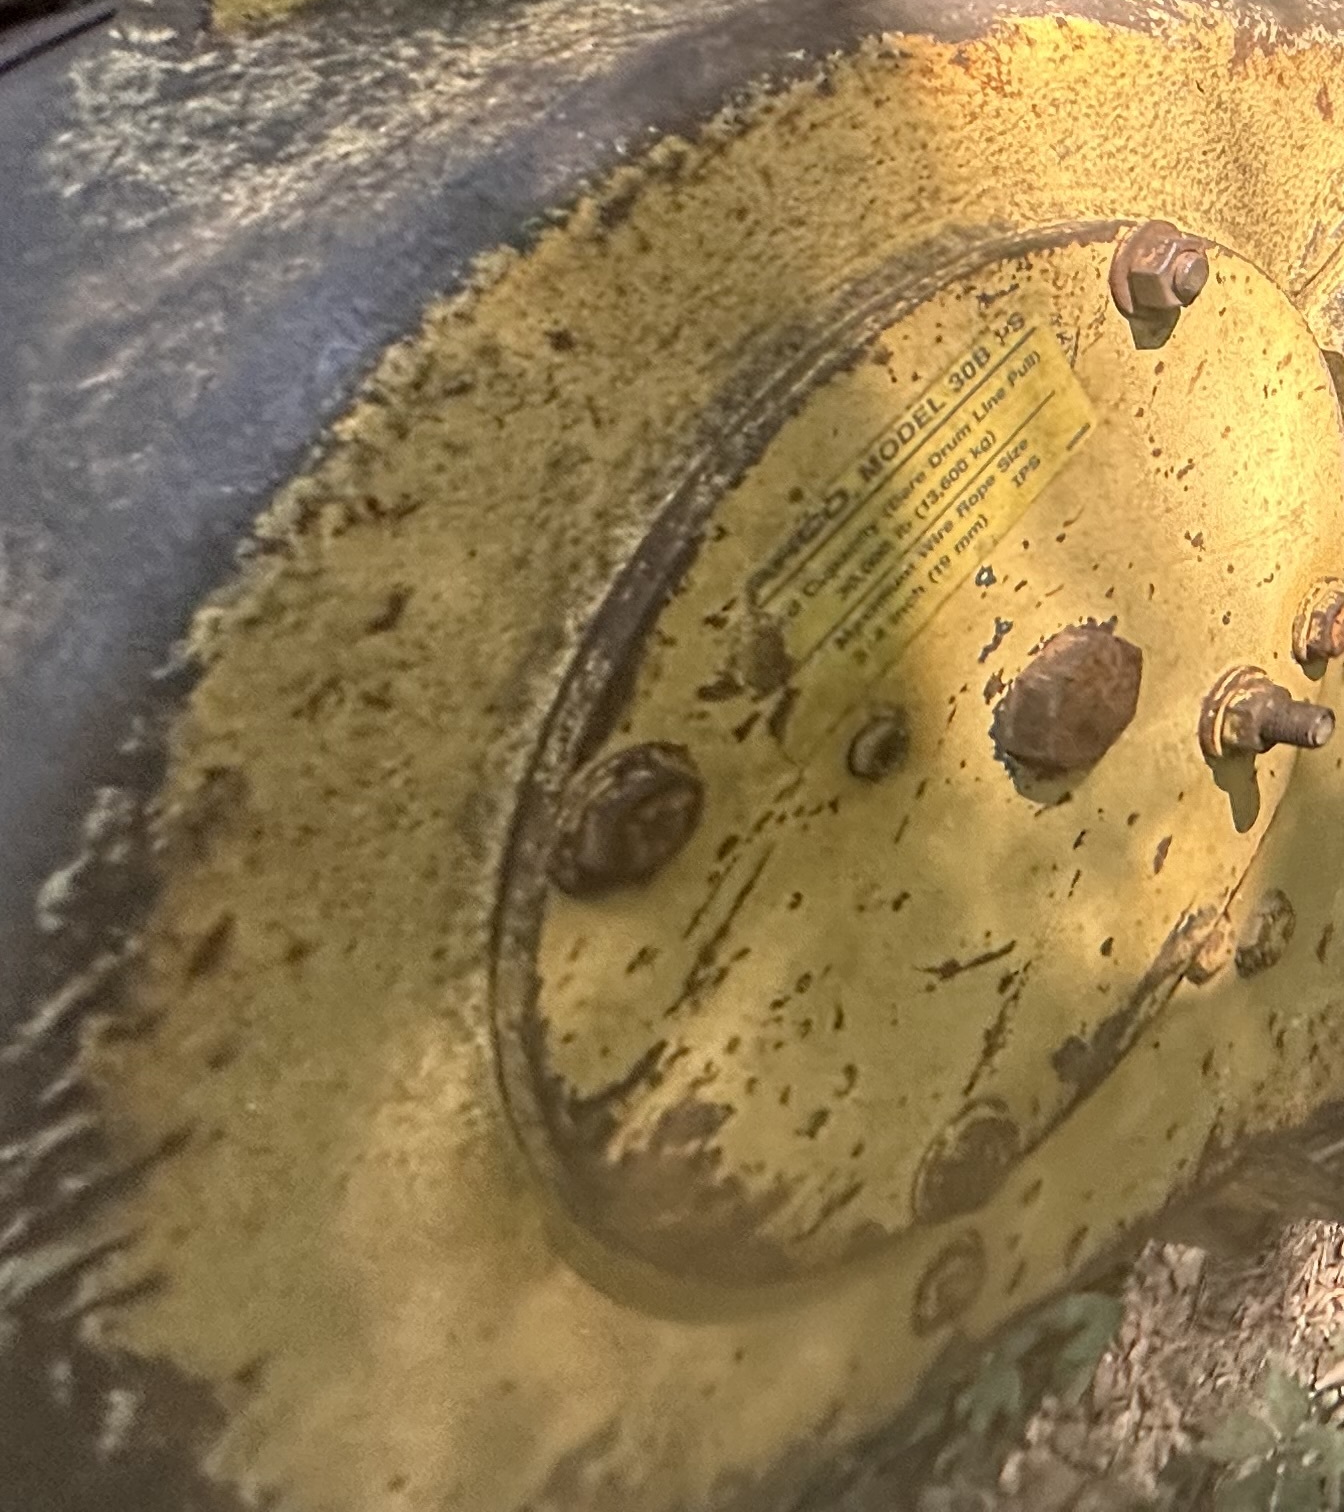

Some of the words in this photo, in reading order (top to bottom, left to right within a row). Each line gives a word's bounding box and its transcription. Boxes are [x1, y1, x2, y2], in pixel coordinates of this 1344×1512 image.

[856, 392, 945, 483] MODEL
[945, 345, 992, 393] 30B
[927, 422, 971, 468] Drum
[971, 386, 1006, 422] Line
[1006, 350, 1042, 387] Pull)
[912, 457, 969, 520] (13,600
[969, 428, 998, 459] kg)
[916, 517, 954, 559] Wire
[955, 474, 998, 517] Rope
[995, 438, 1029, 473] Size
[926, 554, 953, 584] (19
[952, 513, 990, 553] mm)
[1010, 455, 1042, 488] IPS
